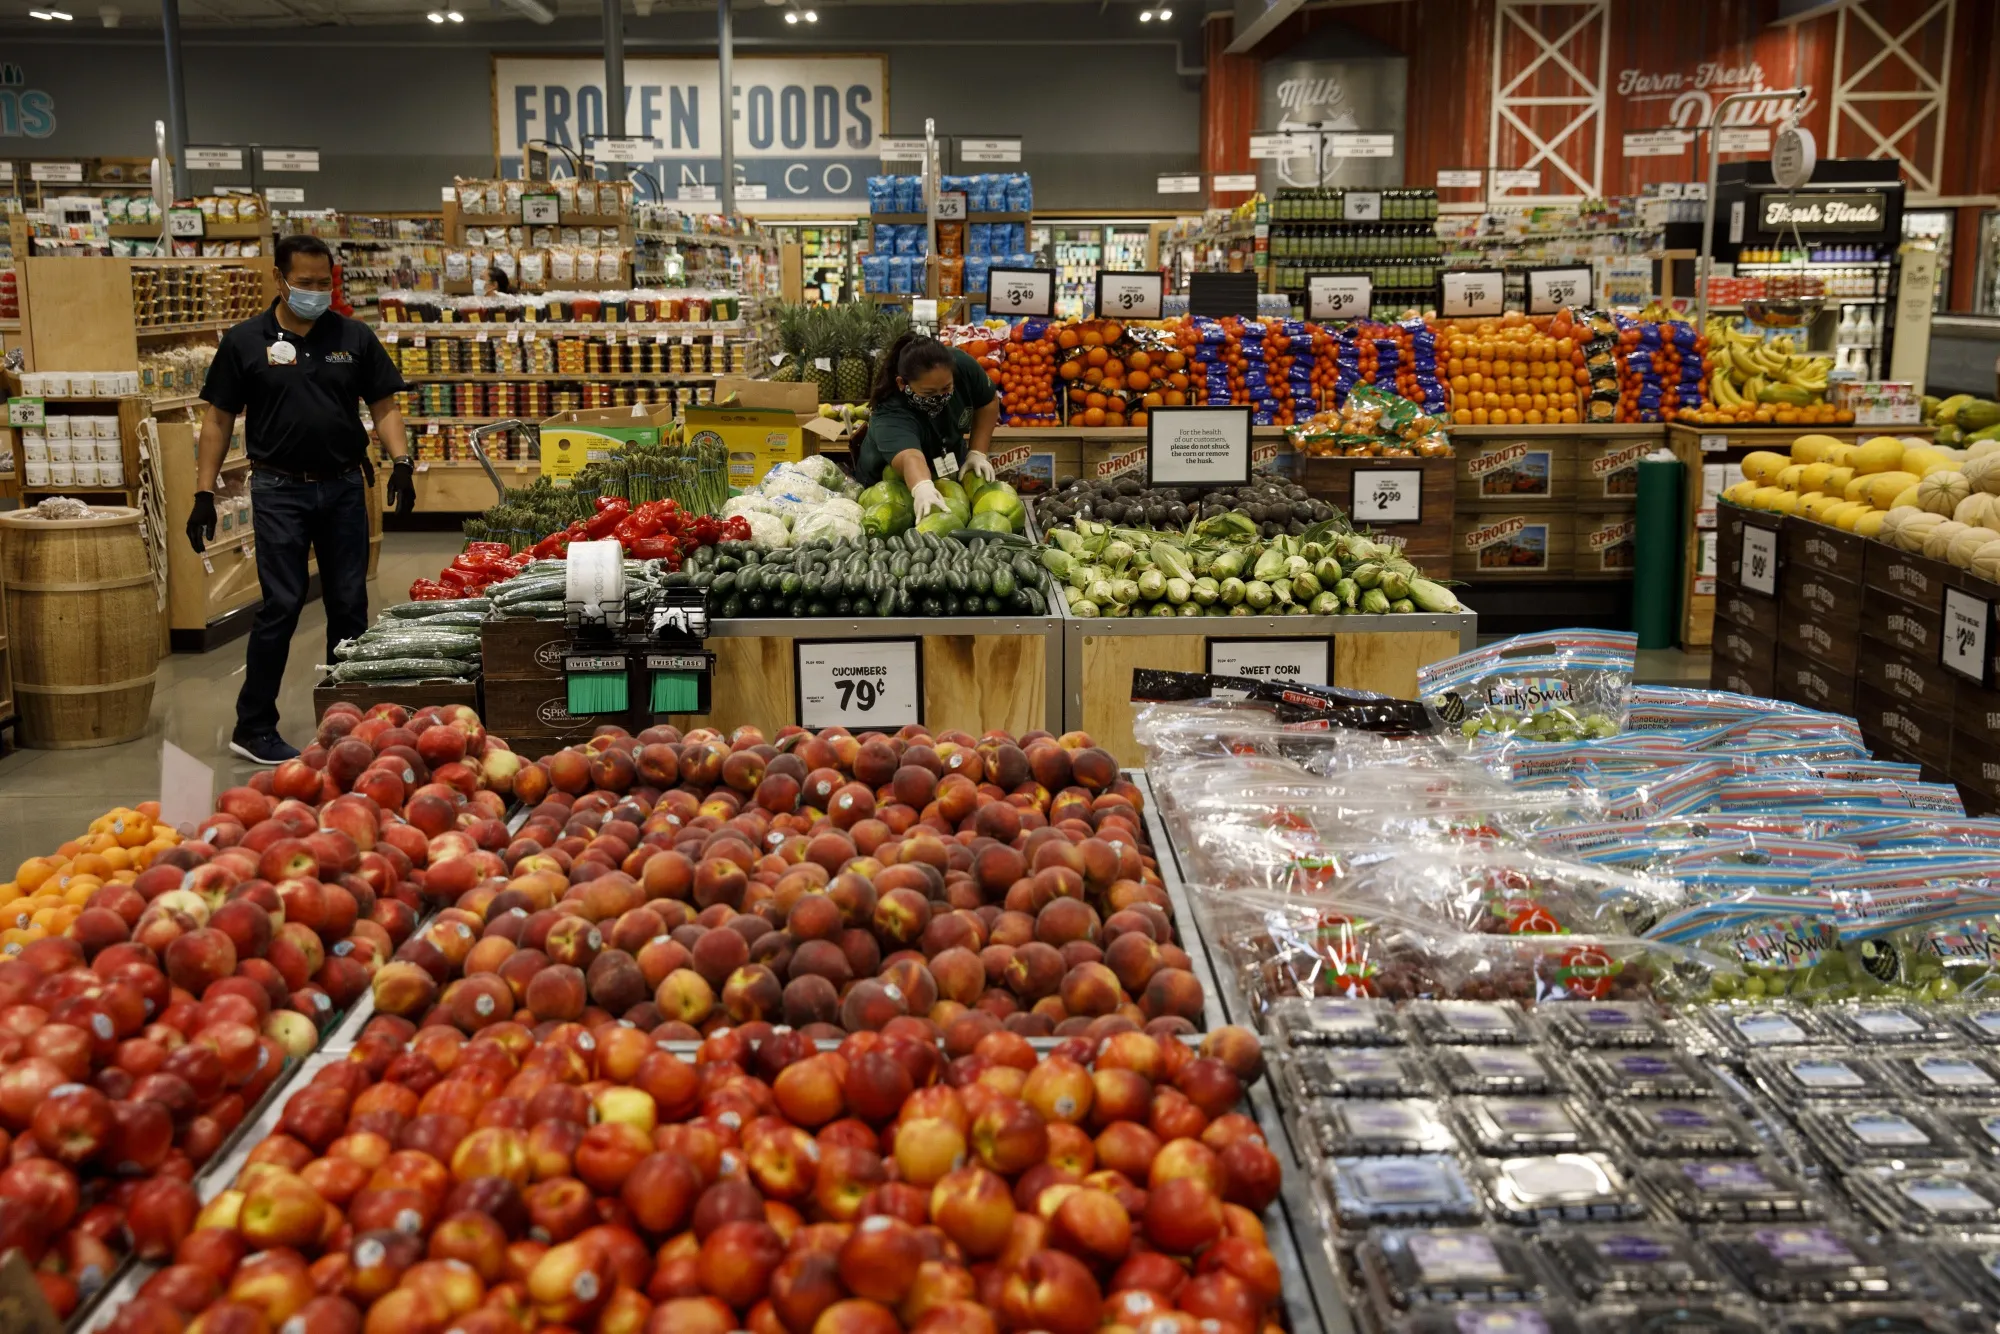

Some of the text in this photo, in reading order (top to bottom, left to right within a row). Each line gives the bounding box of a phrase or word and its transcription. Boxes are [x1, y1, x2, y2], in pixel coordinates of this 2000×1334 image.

[1616, 61, 1766, 96] Farm-Fresh
[1277, 78, 1344, 113] Milk
[514, 85, 699, 149] FROEN
[784, 163, 853, 194] CO
[1823, 201, 1880, 224] Finds
[1193, 436, 1227, 444] customers,
[1098, 446, 1148, 478] SPROUT
[1469, 442, 1528, 474] SPROUTS
[1592, 442, 1652, 474] SPROUTS
[1467, 517, 1525, 547] SPROUTS
[1888, 564, 1928, 592] FARM-FRESH
[1887, 615, 1928, 645] FARM-FRESH
[832, 665, 887, 677] CUCUMBERS
[1240, 664, 1301, 675] SWEET CORN
[834, 677, 886, 712] 79¢
